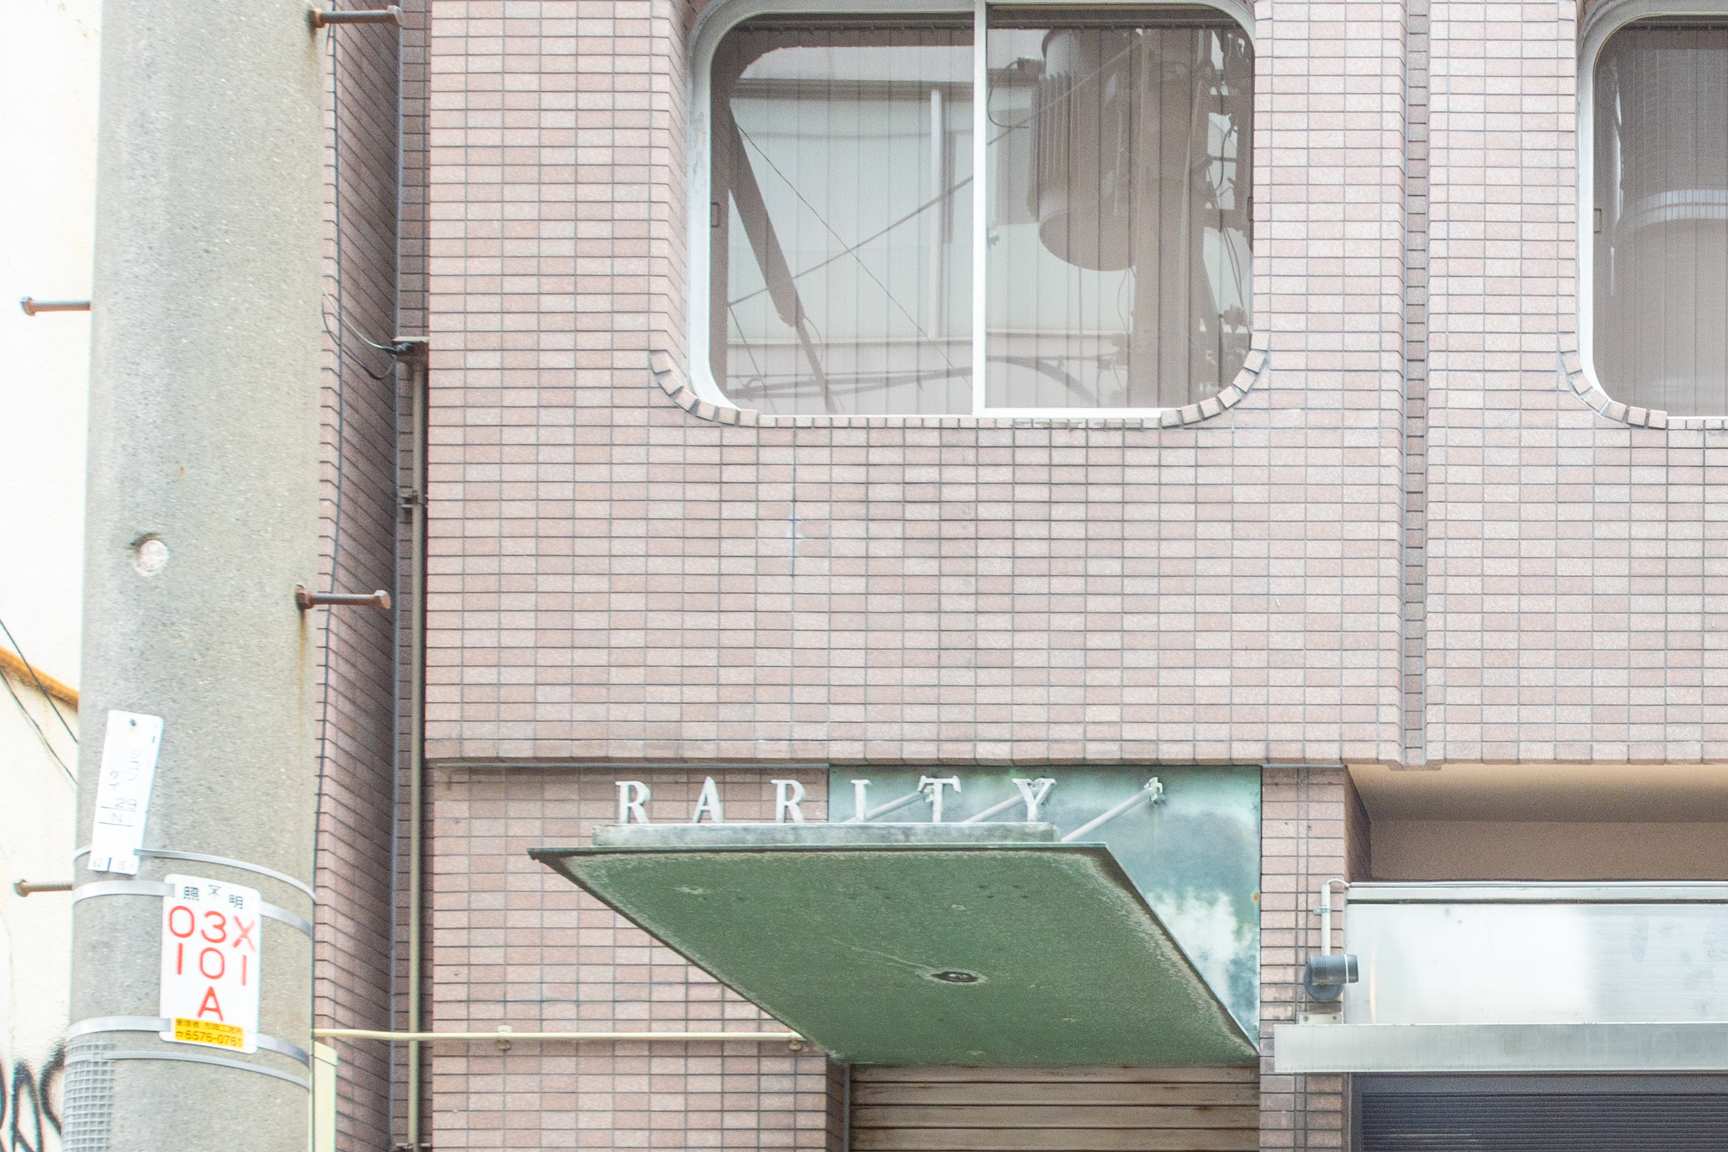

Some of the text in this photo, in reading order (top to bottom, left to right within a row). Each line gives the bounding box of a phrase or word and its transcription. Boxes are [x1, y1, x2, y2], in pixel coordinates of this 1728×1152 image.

[616, 776, 1056, 824] RARITY
[176, 943, 247, 986] 101
[198, 986, 224, 1022] A
